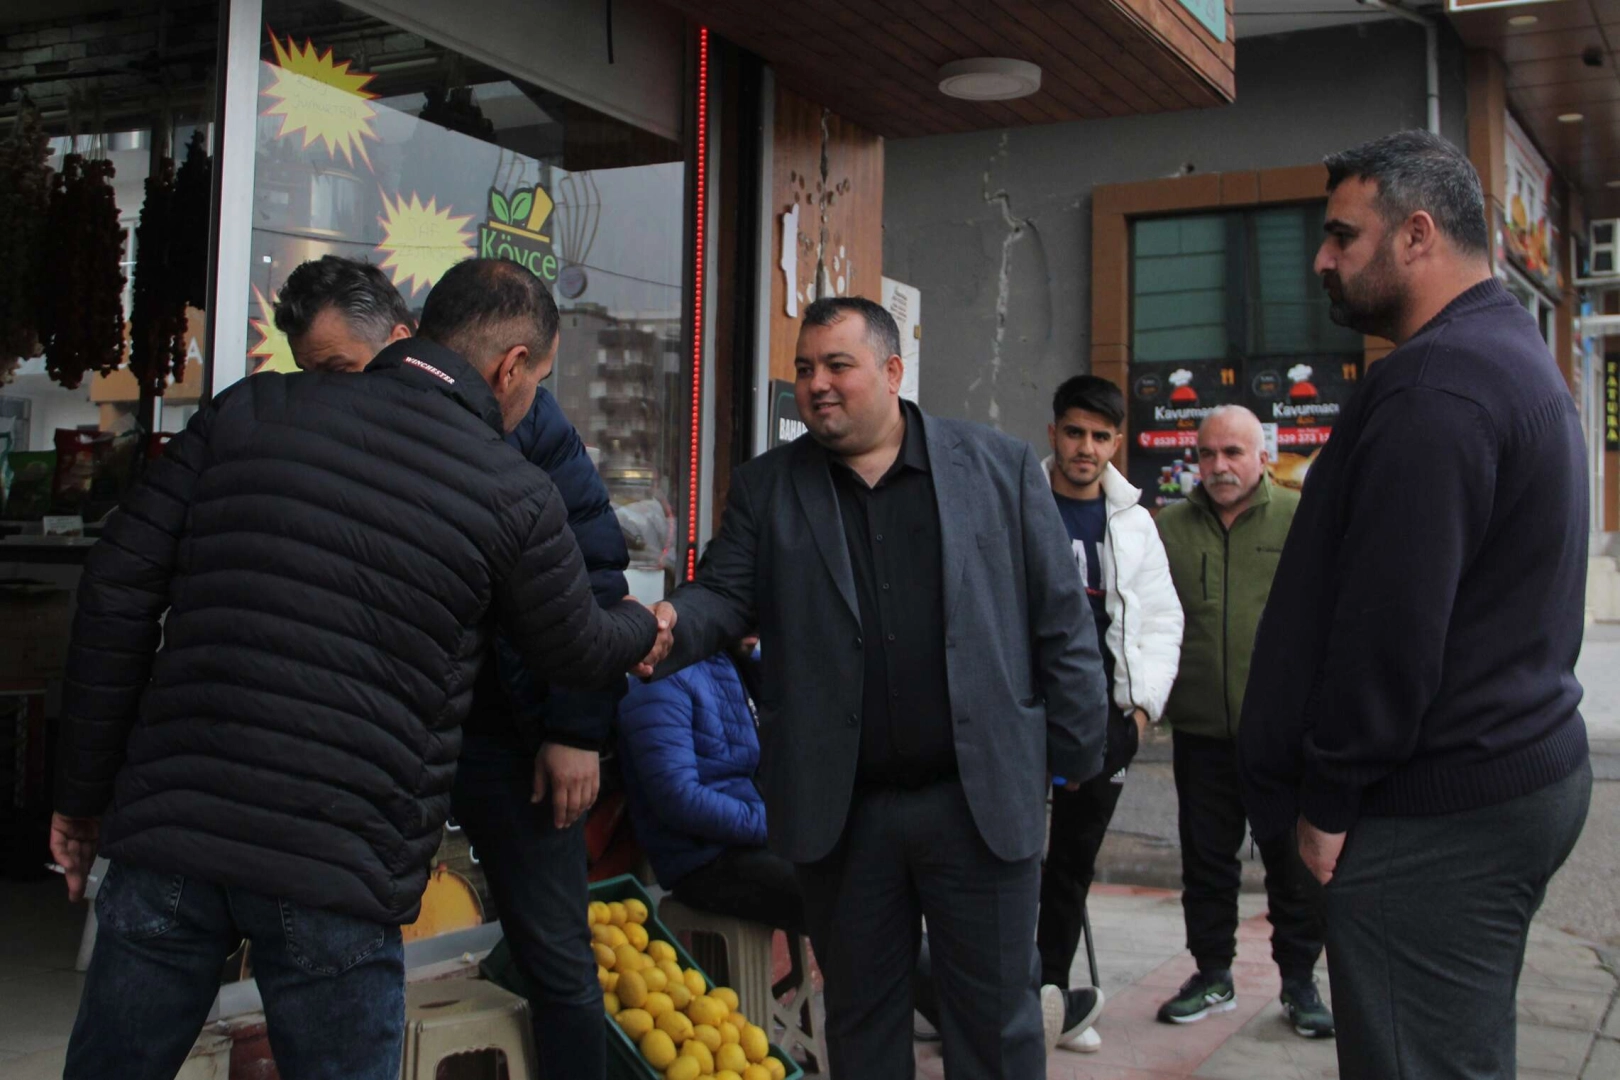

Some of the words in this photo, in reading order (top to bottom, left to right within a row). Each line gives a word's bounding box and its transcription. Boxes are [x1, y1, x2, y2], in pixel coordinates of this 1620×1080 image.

[405, 356, 456, 385] WINCHESTER
[1154, 405, 1212, 421] Kavurma
[1606, 361, 1619, 441] FATURA
